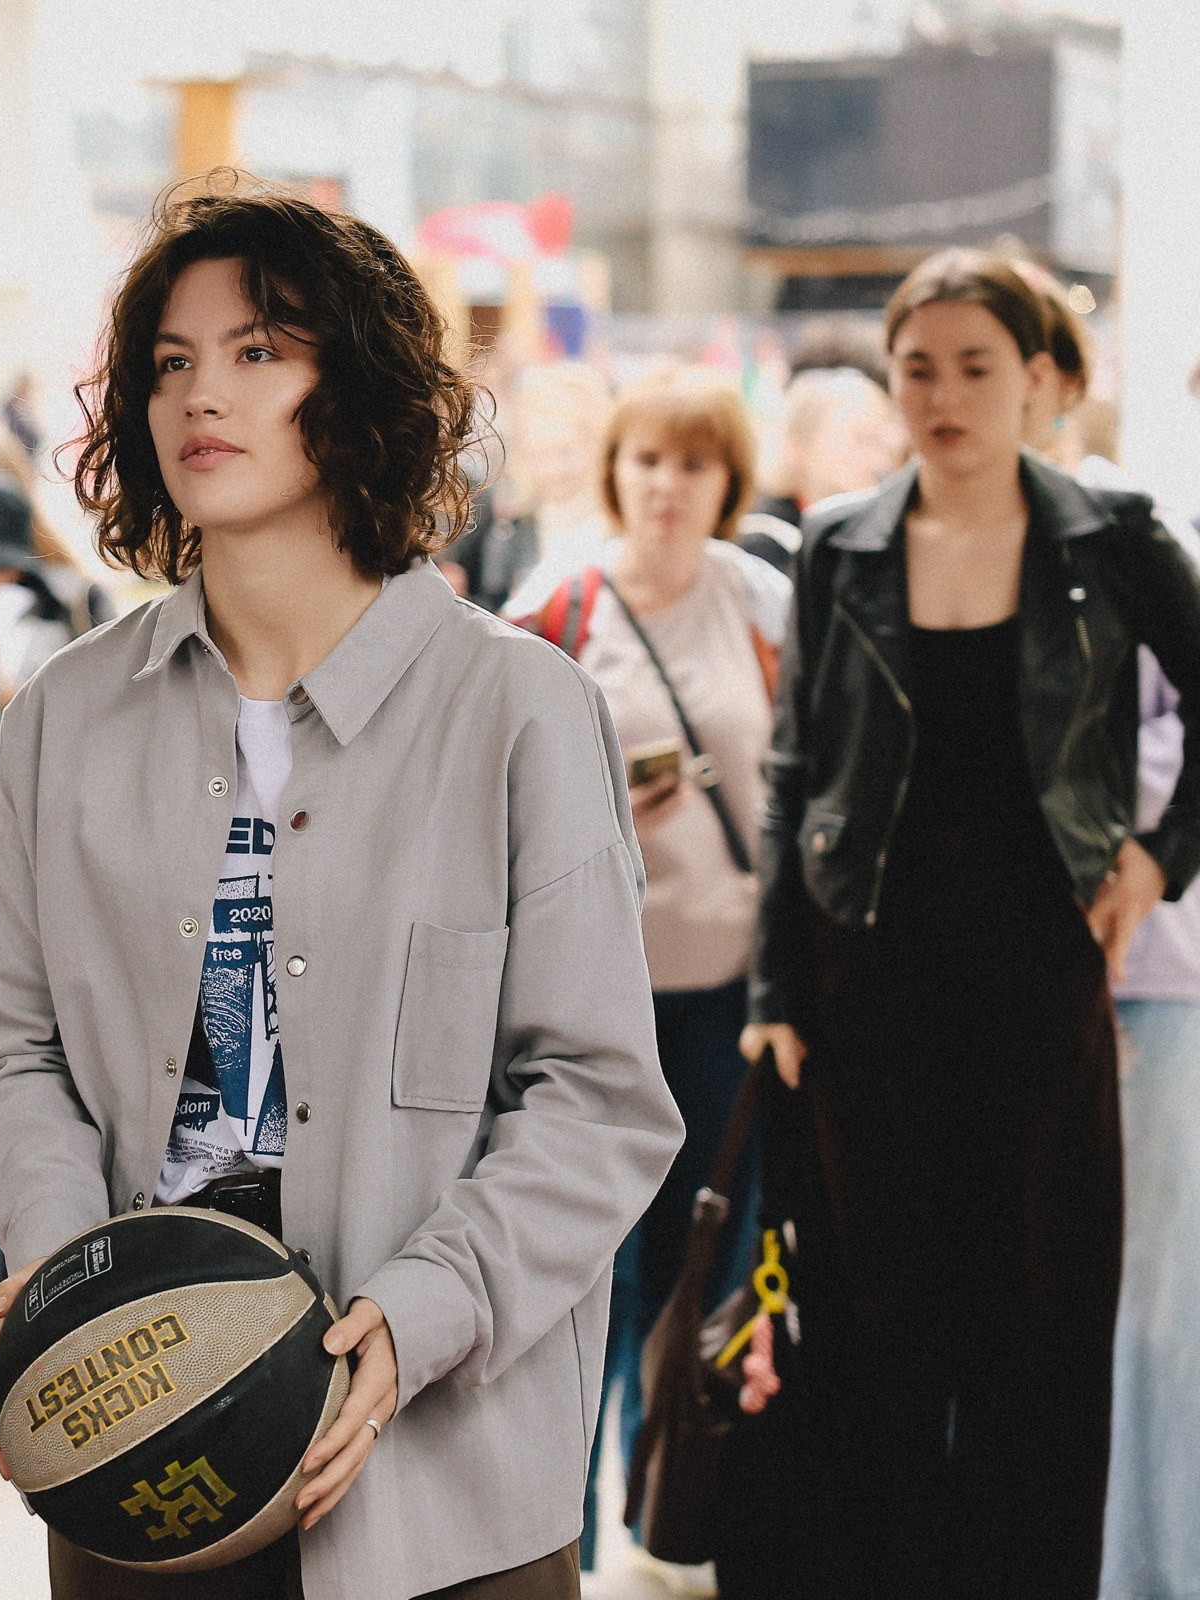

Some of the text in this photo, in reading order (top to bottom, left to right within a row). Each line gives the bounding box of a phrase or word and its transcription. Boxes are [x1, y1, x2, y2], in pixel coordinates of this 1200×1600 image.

[228, 905, 271, 923] 2020
[211, 947, 243, 962] free
[25, 1312, 190, 1436] CONTEST
[62, 1361, 176, 1450] KICKS
